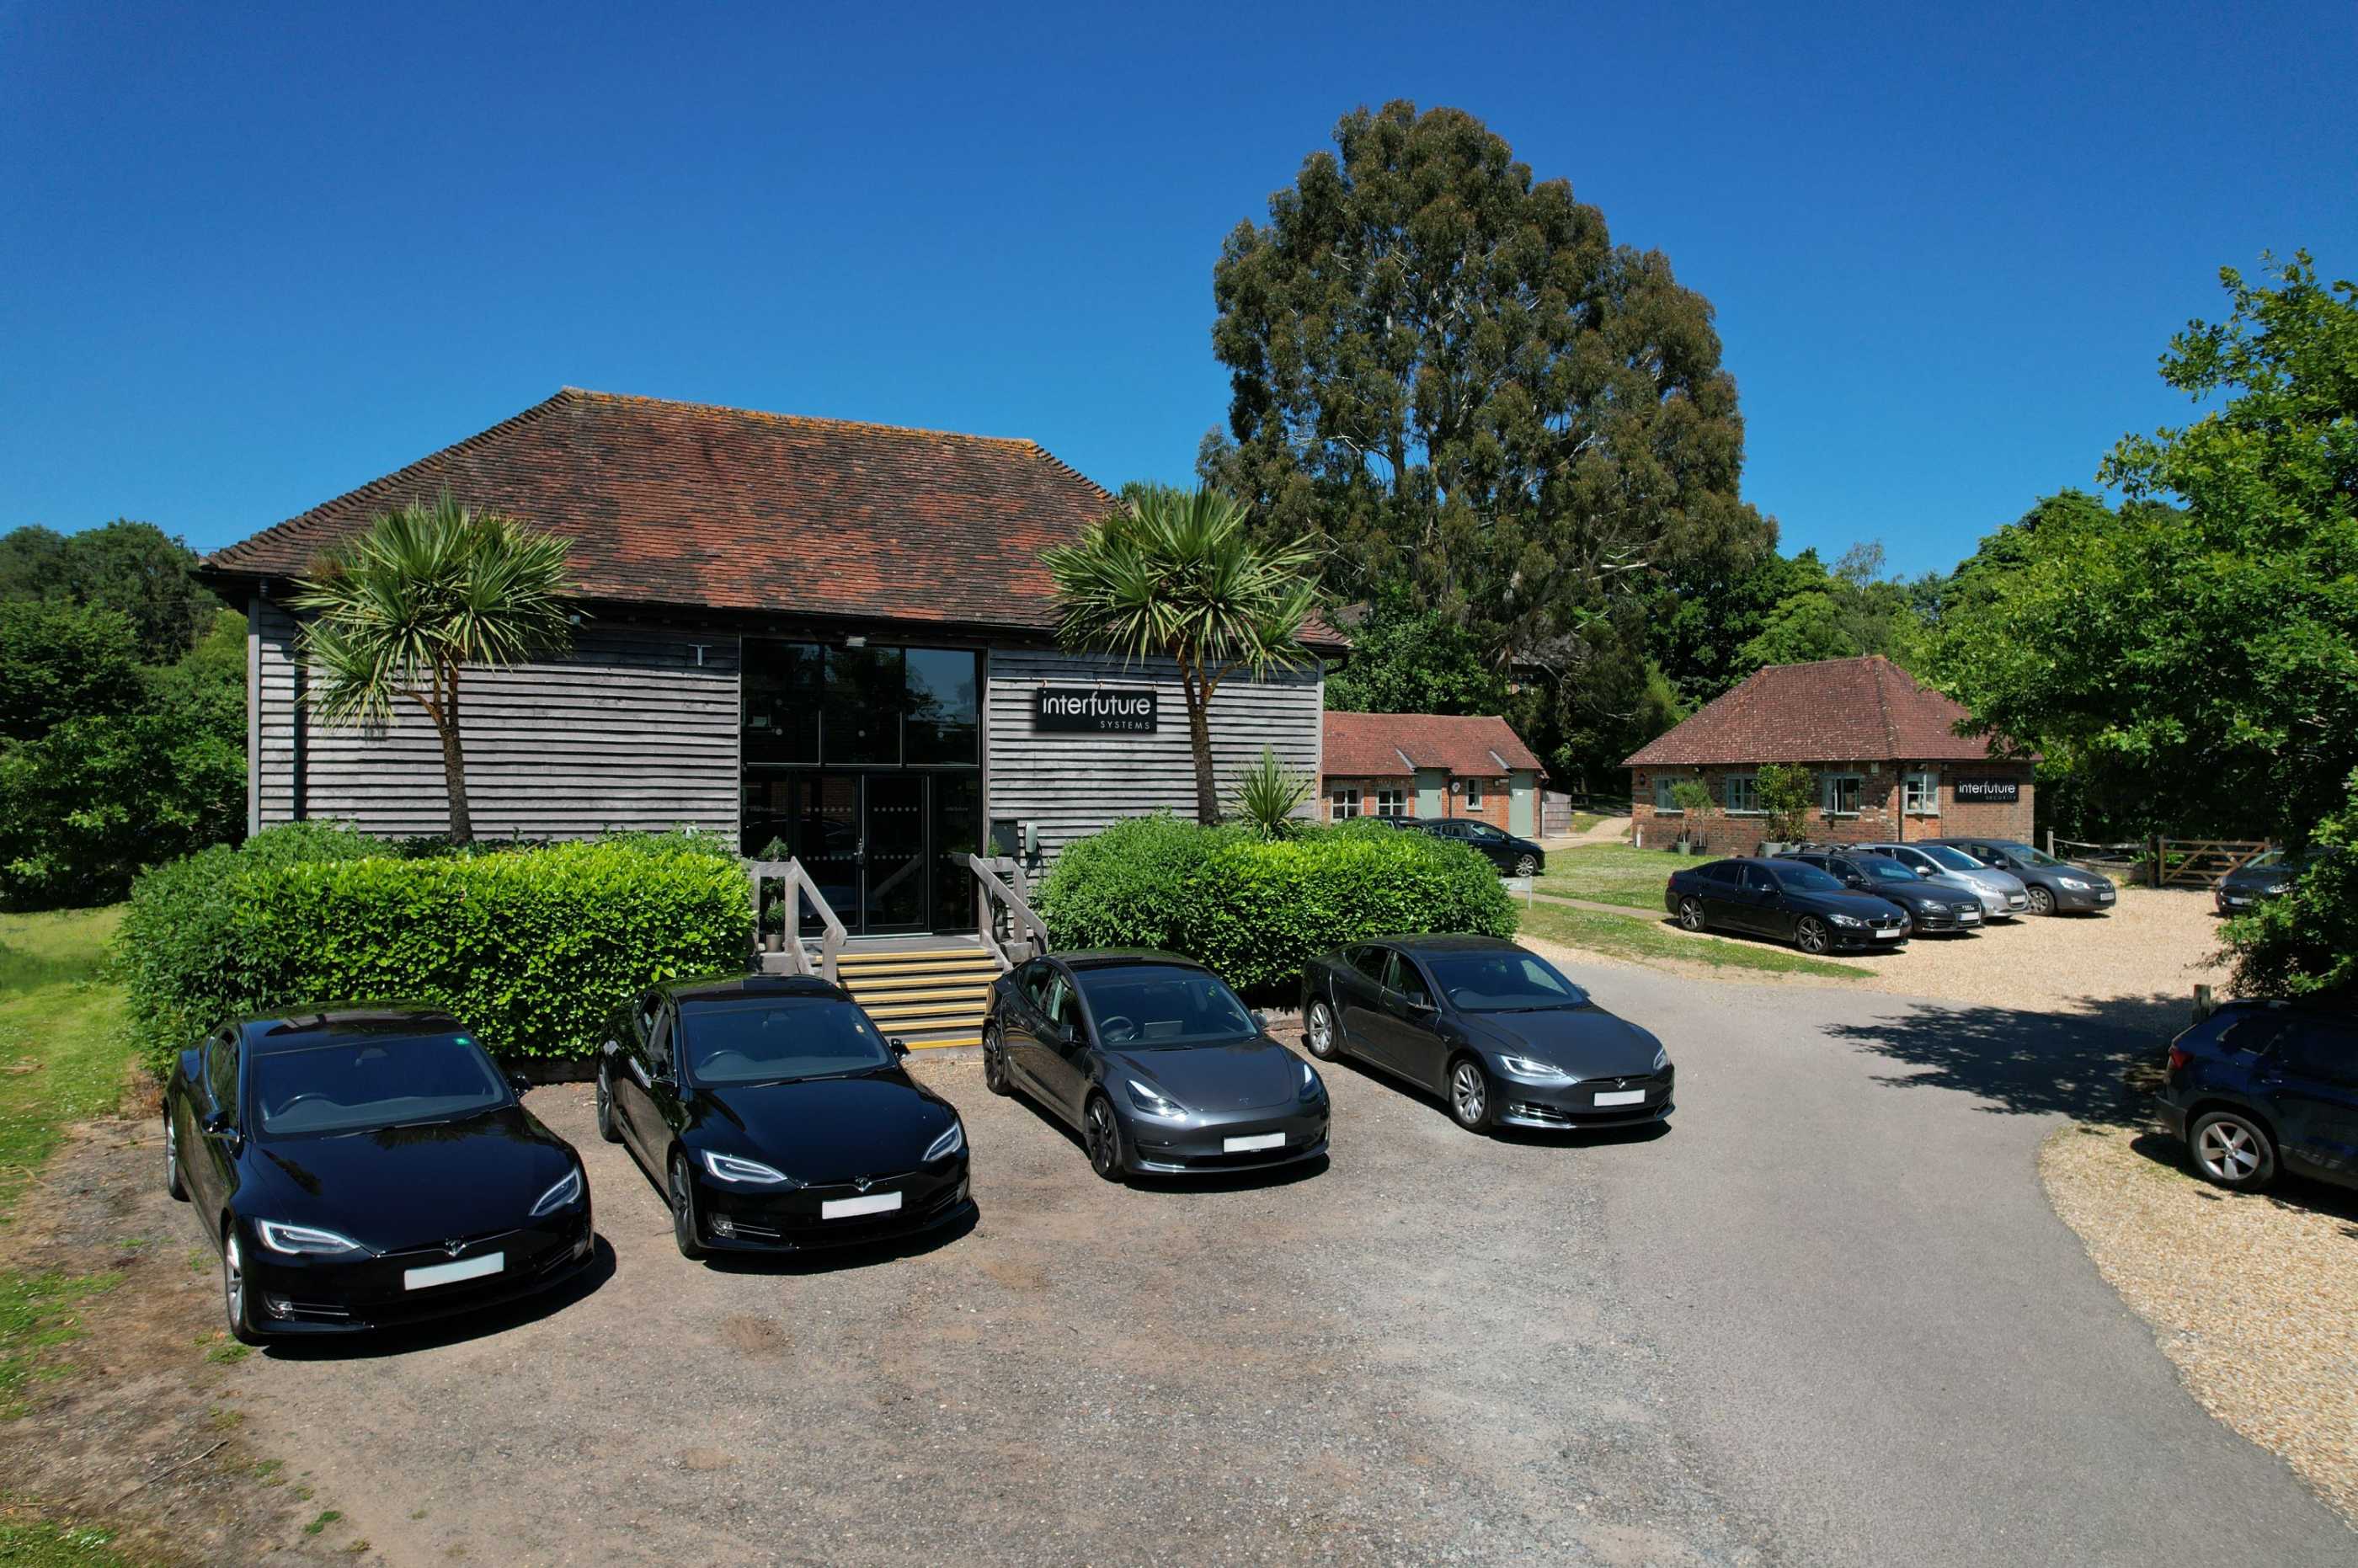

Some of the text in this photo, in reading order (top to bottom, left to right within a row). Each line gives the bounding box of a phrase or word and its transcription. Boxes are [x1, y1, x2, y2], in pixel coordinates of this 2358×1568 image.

[1043, 691, 1150, 717] interfuture
[1100, 721, 1150, 730] SYSTEMS
[1959, 781, 2016, 795] interfuture
